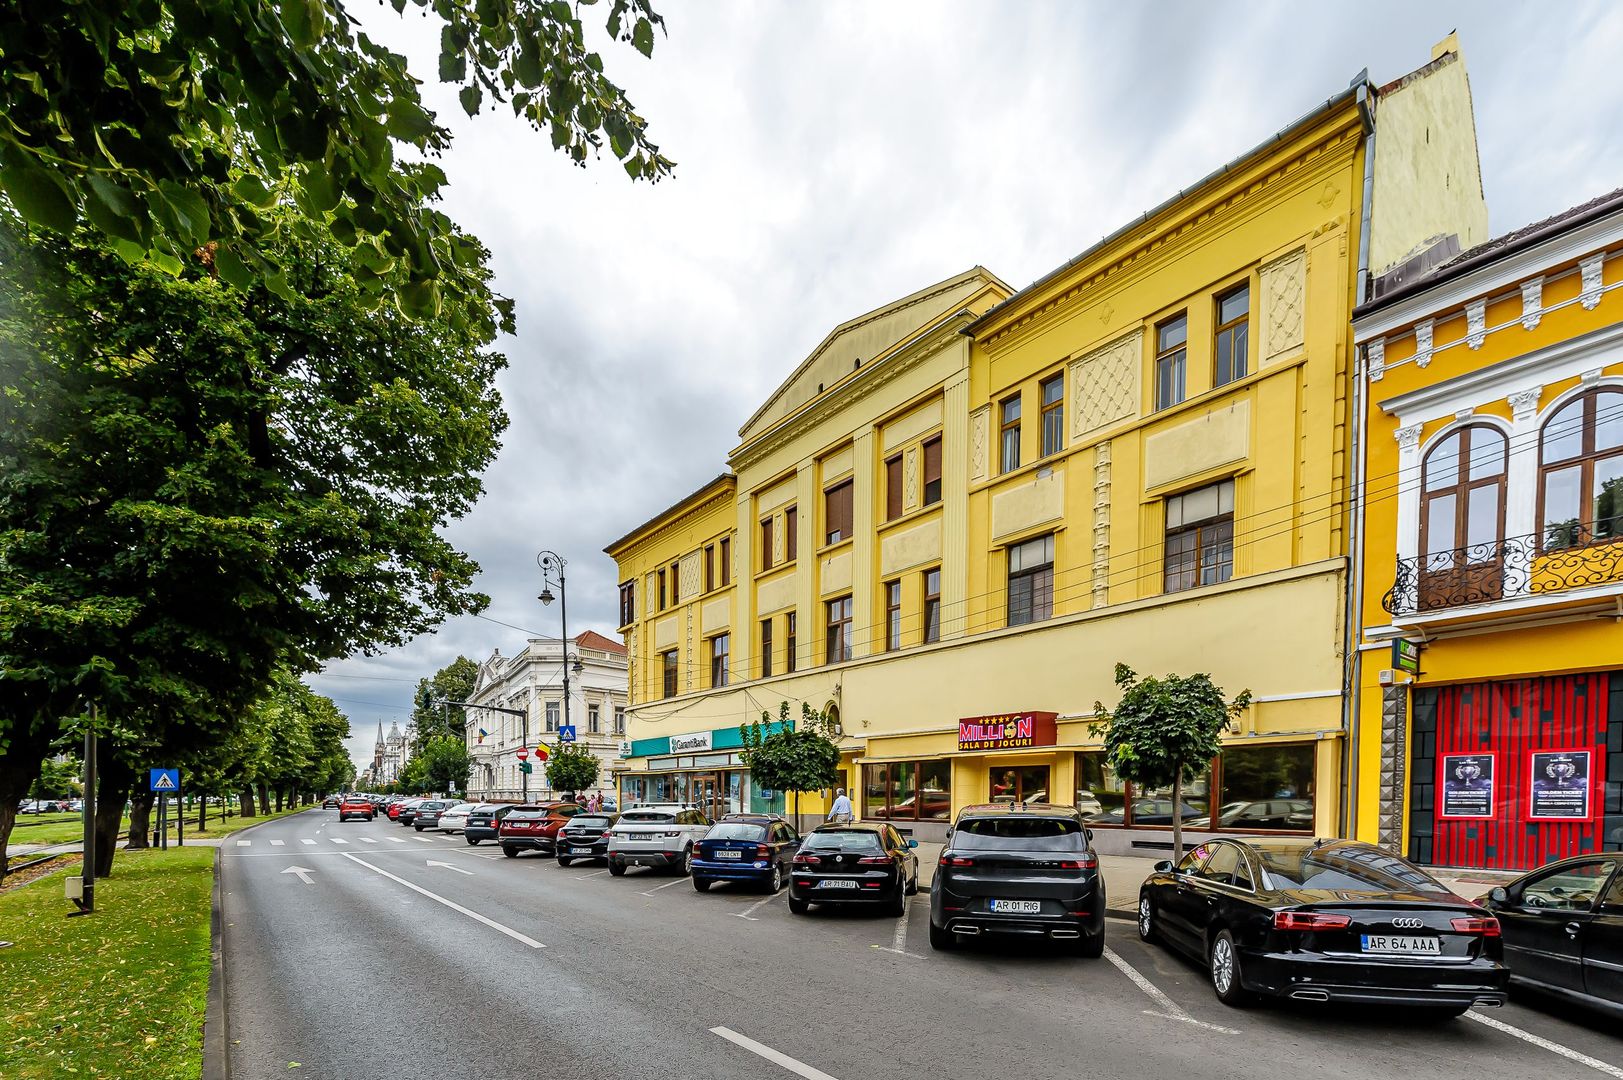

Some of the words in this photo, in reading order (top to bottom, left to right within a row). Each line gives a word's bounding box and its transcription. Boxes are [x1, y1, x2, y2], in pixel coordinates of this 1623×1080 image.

[959, 716, 1032, 742] MILLION
[959, 742, 980, 750] SALA
[998, 738, 1032, 748] JOCURI
[824, 880, 833, 888] AR
[995, 901, 1009, 910] AR
[1011, 901, 1020, 910] 01
[1023, 902, 1039, 911] RIG
[1370, 937, 1387, 949] AR
[1391, 938, 1407, 949] 64
[1412, 939, 1435, 950] AAA
